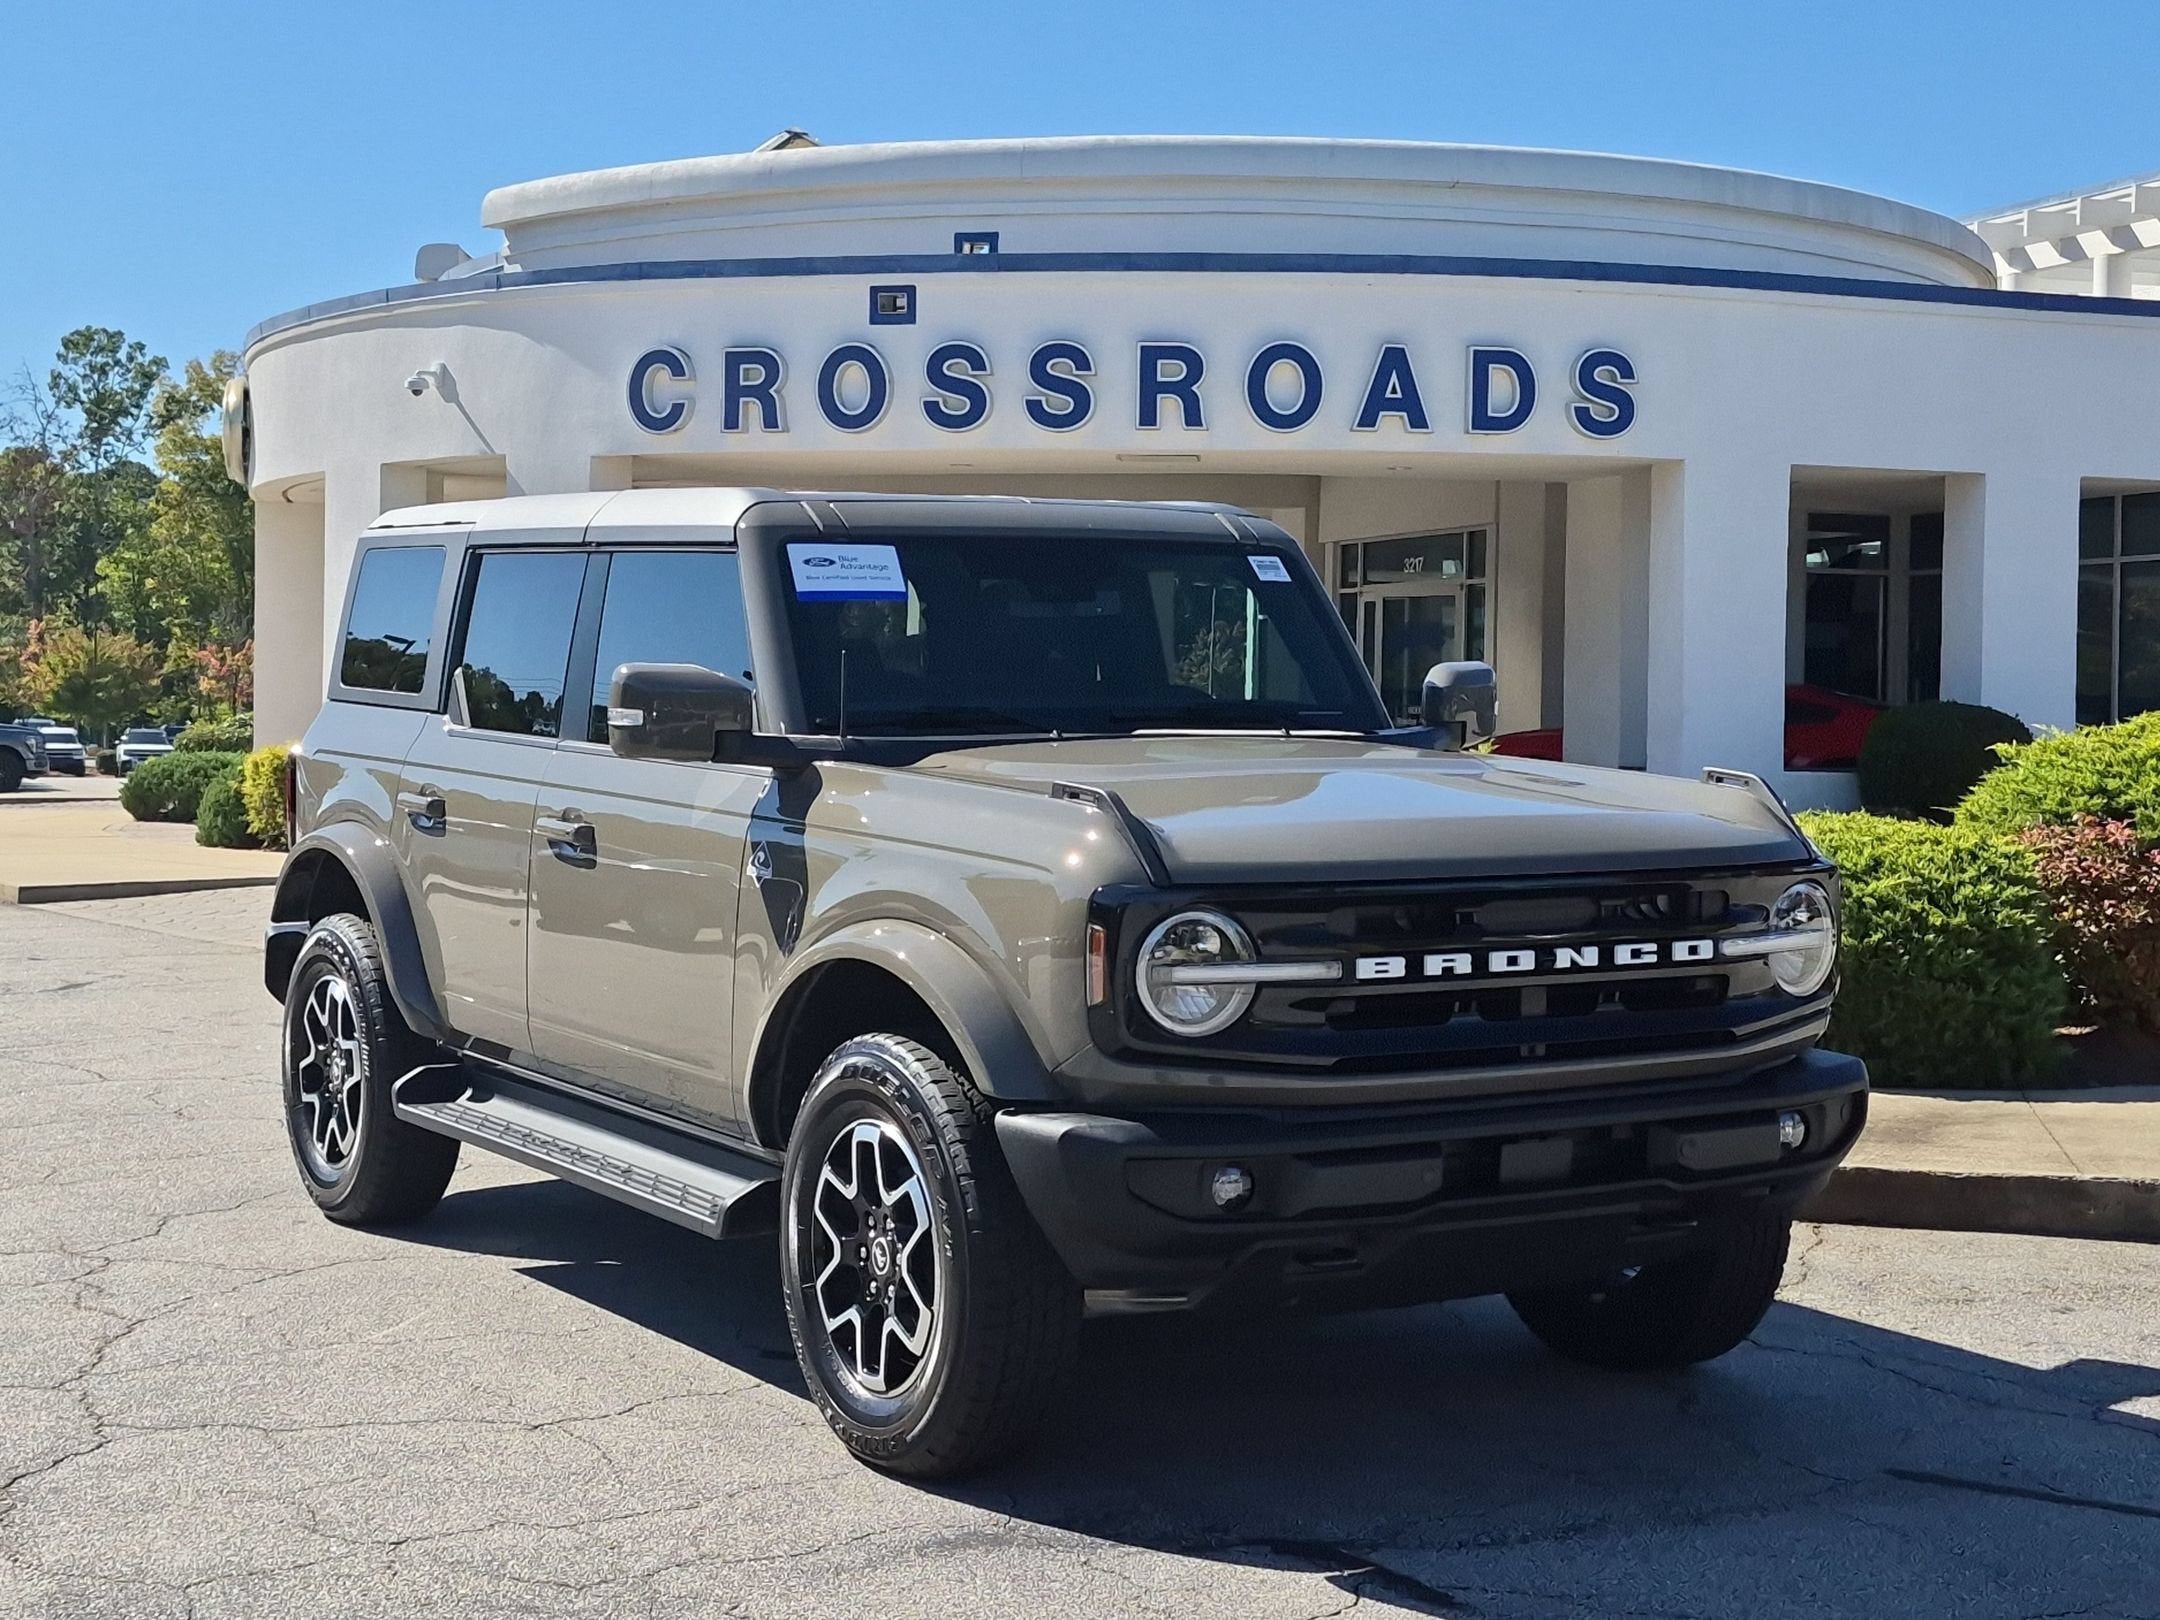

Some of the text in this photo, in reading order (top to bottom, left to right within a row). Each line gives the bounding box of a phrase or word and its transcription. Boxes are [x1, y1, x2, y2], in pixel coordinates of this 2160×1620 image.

[629, 341, 1638, 438] CROSSROADS
[840, 563, 888, 571] Advantage
[1403, 556, 1424, 573] 3217
[1356, 939, 1714, 979] BRONCO
